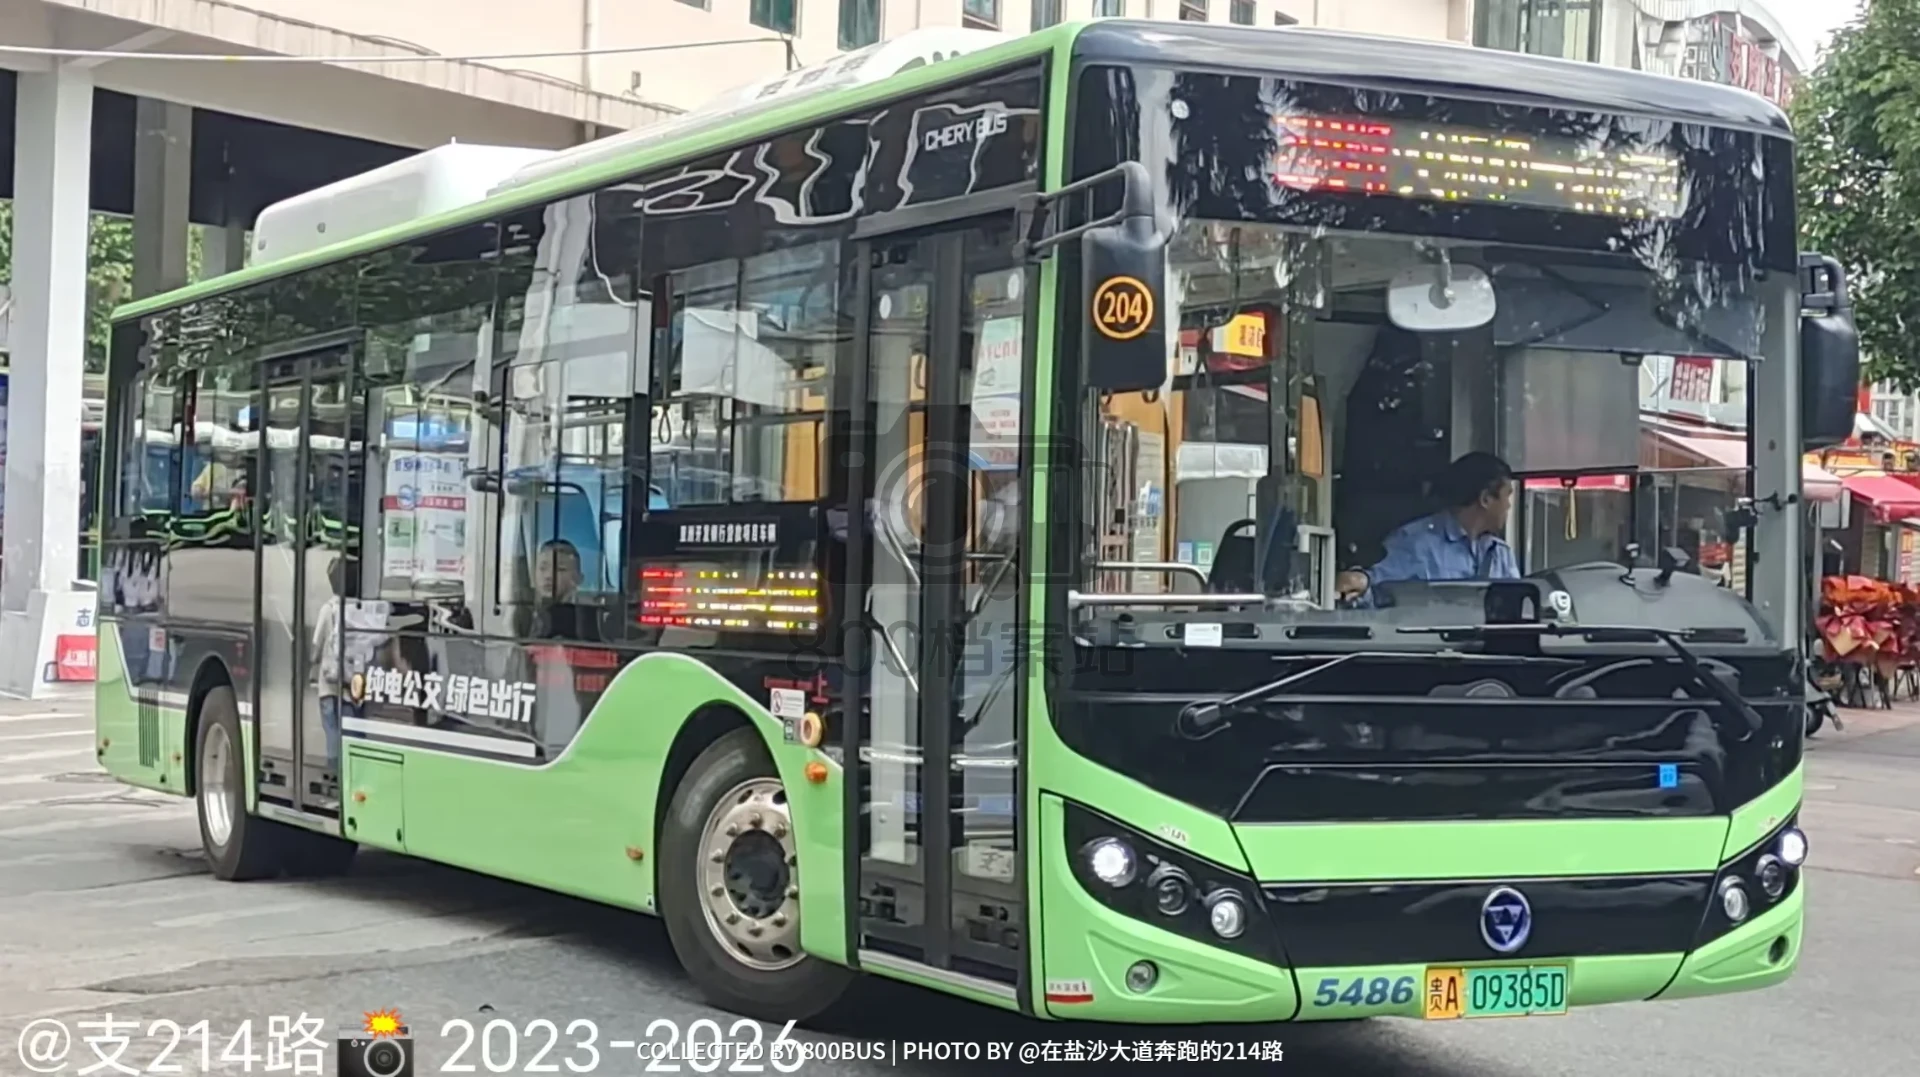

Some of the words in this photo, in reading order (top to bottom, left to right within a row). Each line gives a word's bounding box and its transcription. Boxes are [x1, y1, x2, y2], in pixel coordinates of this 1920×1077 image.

[925, 120, 975, 151] CHERY
[976, 112, 1008, 138] BUS
[1103, 291, 1143, 324] 204
[364, 665, 444, 712] 纯电公交
[445, 673, 537, 723] 绿色出行
[1313, 976, 1415, 1007] 5486
[1429, 975, 1459, 1012] 贵A
[1472, 972, 1565, 1010] 09385D
